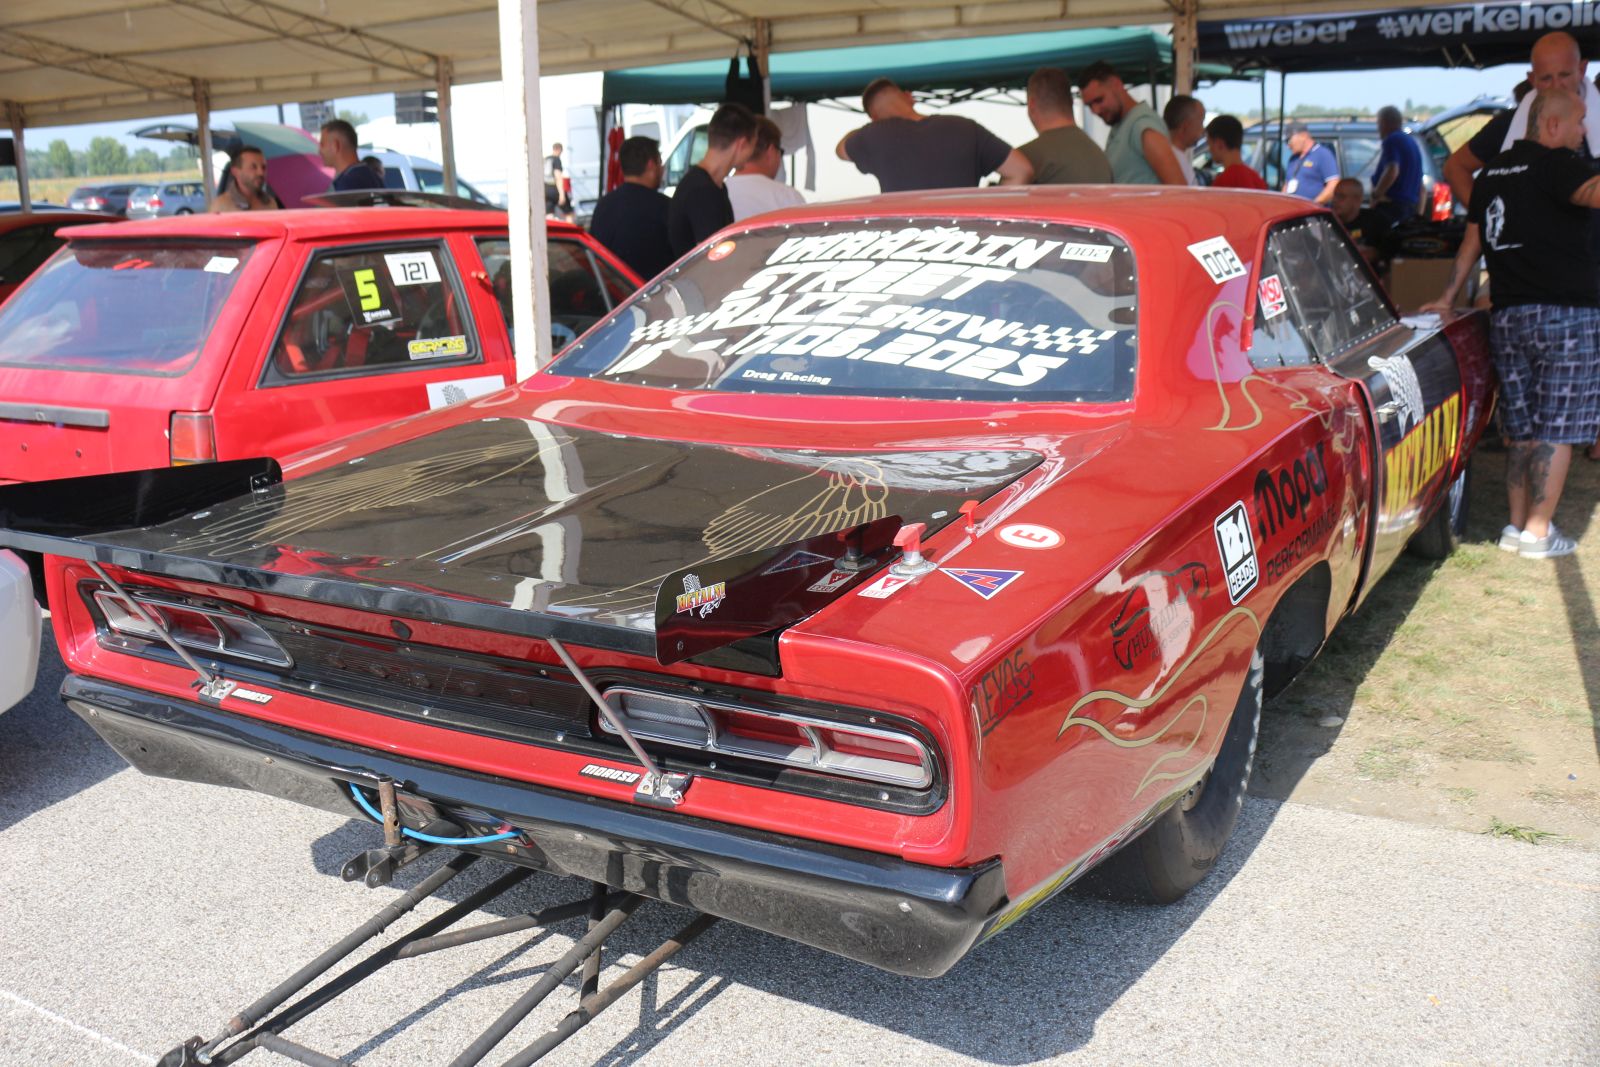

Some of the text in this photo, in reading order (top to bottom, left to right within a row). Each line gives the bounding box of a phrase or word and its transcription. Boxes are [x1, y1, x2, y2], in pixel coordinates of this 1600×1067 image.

[401, 262, 429, 281] 121
[1202, 247, 1242, 279] 002
[354, 268, 381, 311] 5
[721, 260, 1017, 302] STREET
[1260, 278, 1281, 305] MSD
[604, 338, 681, 375] 16
[721, 325, 1069, 387] 17.08.2025
[742, 369, 832, 386] Drag Racing
[1230, 560, 1254, 592] HEADS
[581, 764, 641, 783] MOROSO
